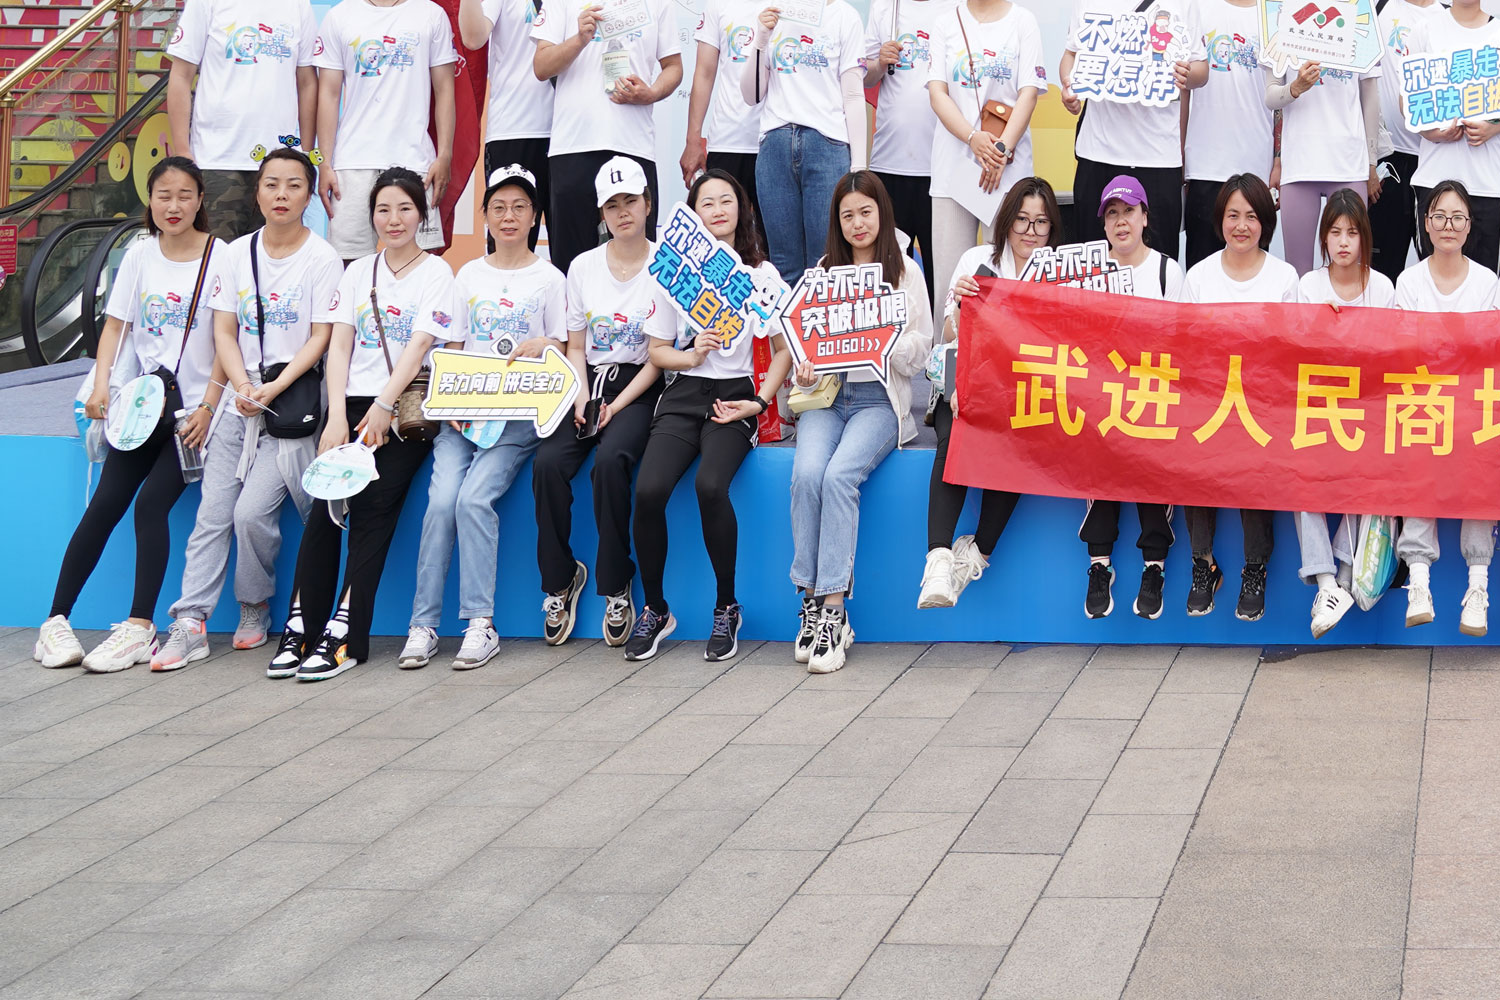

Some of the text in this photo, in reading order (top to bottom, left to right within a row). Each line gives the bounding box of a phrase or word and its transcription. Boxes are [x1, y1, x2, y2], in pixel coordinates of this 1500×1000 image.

[1079, 13, 1148, 55] 不燃
[1289, 27, 1344, 43] 武进人民商场
[1071, 53, 1180, 100] 要怎样
[1403, 44, 1498, 92] 沉迷暴走
[664, 208, 756, 310] 沉迷暴走
[1033, 242, 1110, 283] 为不凡
[649, 241, 745, 350] 无法自拔
[804, 266, 884, 304] 为不凡
[800, 291, 907, 341] 突破极限
[438, 371, 565, 395] 努力向前 拼尽全力
